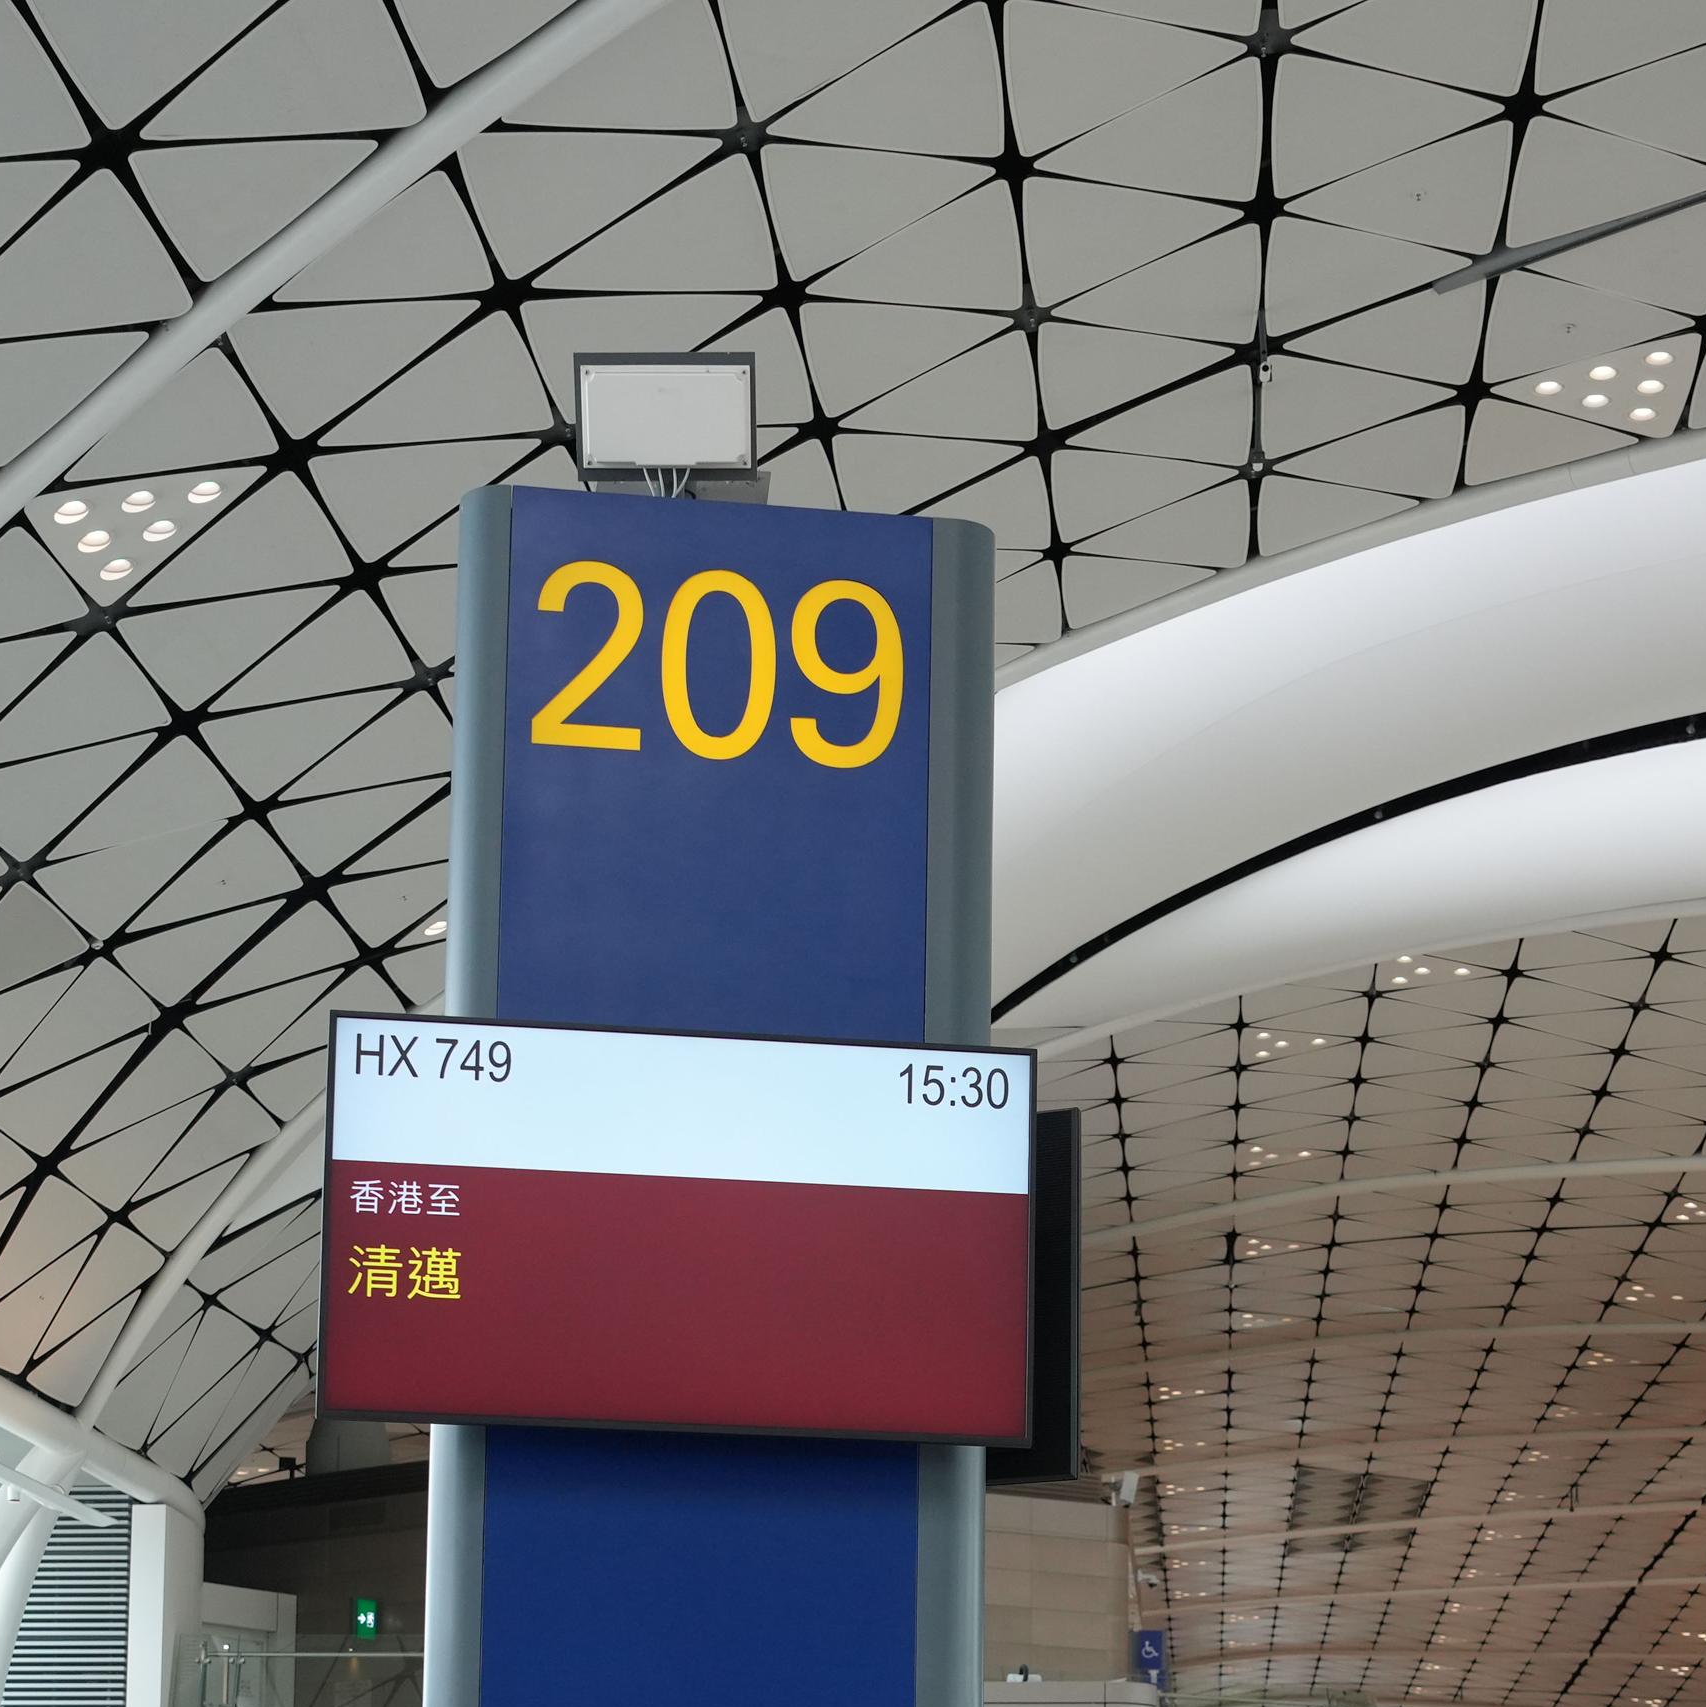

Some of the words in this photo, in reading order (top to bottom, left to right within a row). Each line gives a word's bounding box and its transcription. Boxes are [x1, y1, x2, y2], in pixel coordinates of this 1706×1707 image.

[531, 560, 905, 769] 209
[356, 1033, 419, 1077] HX
[436, 1038, 512, 1082] 749
[899, 1063, 1009, 1110] 15:30
[350, 1179, 461, 1216] 香港至
[348, 1244, 462, 1299] 清邁
